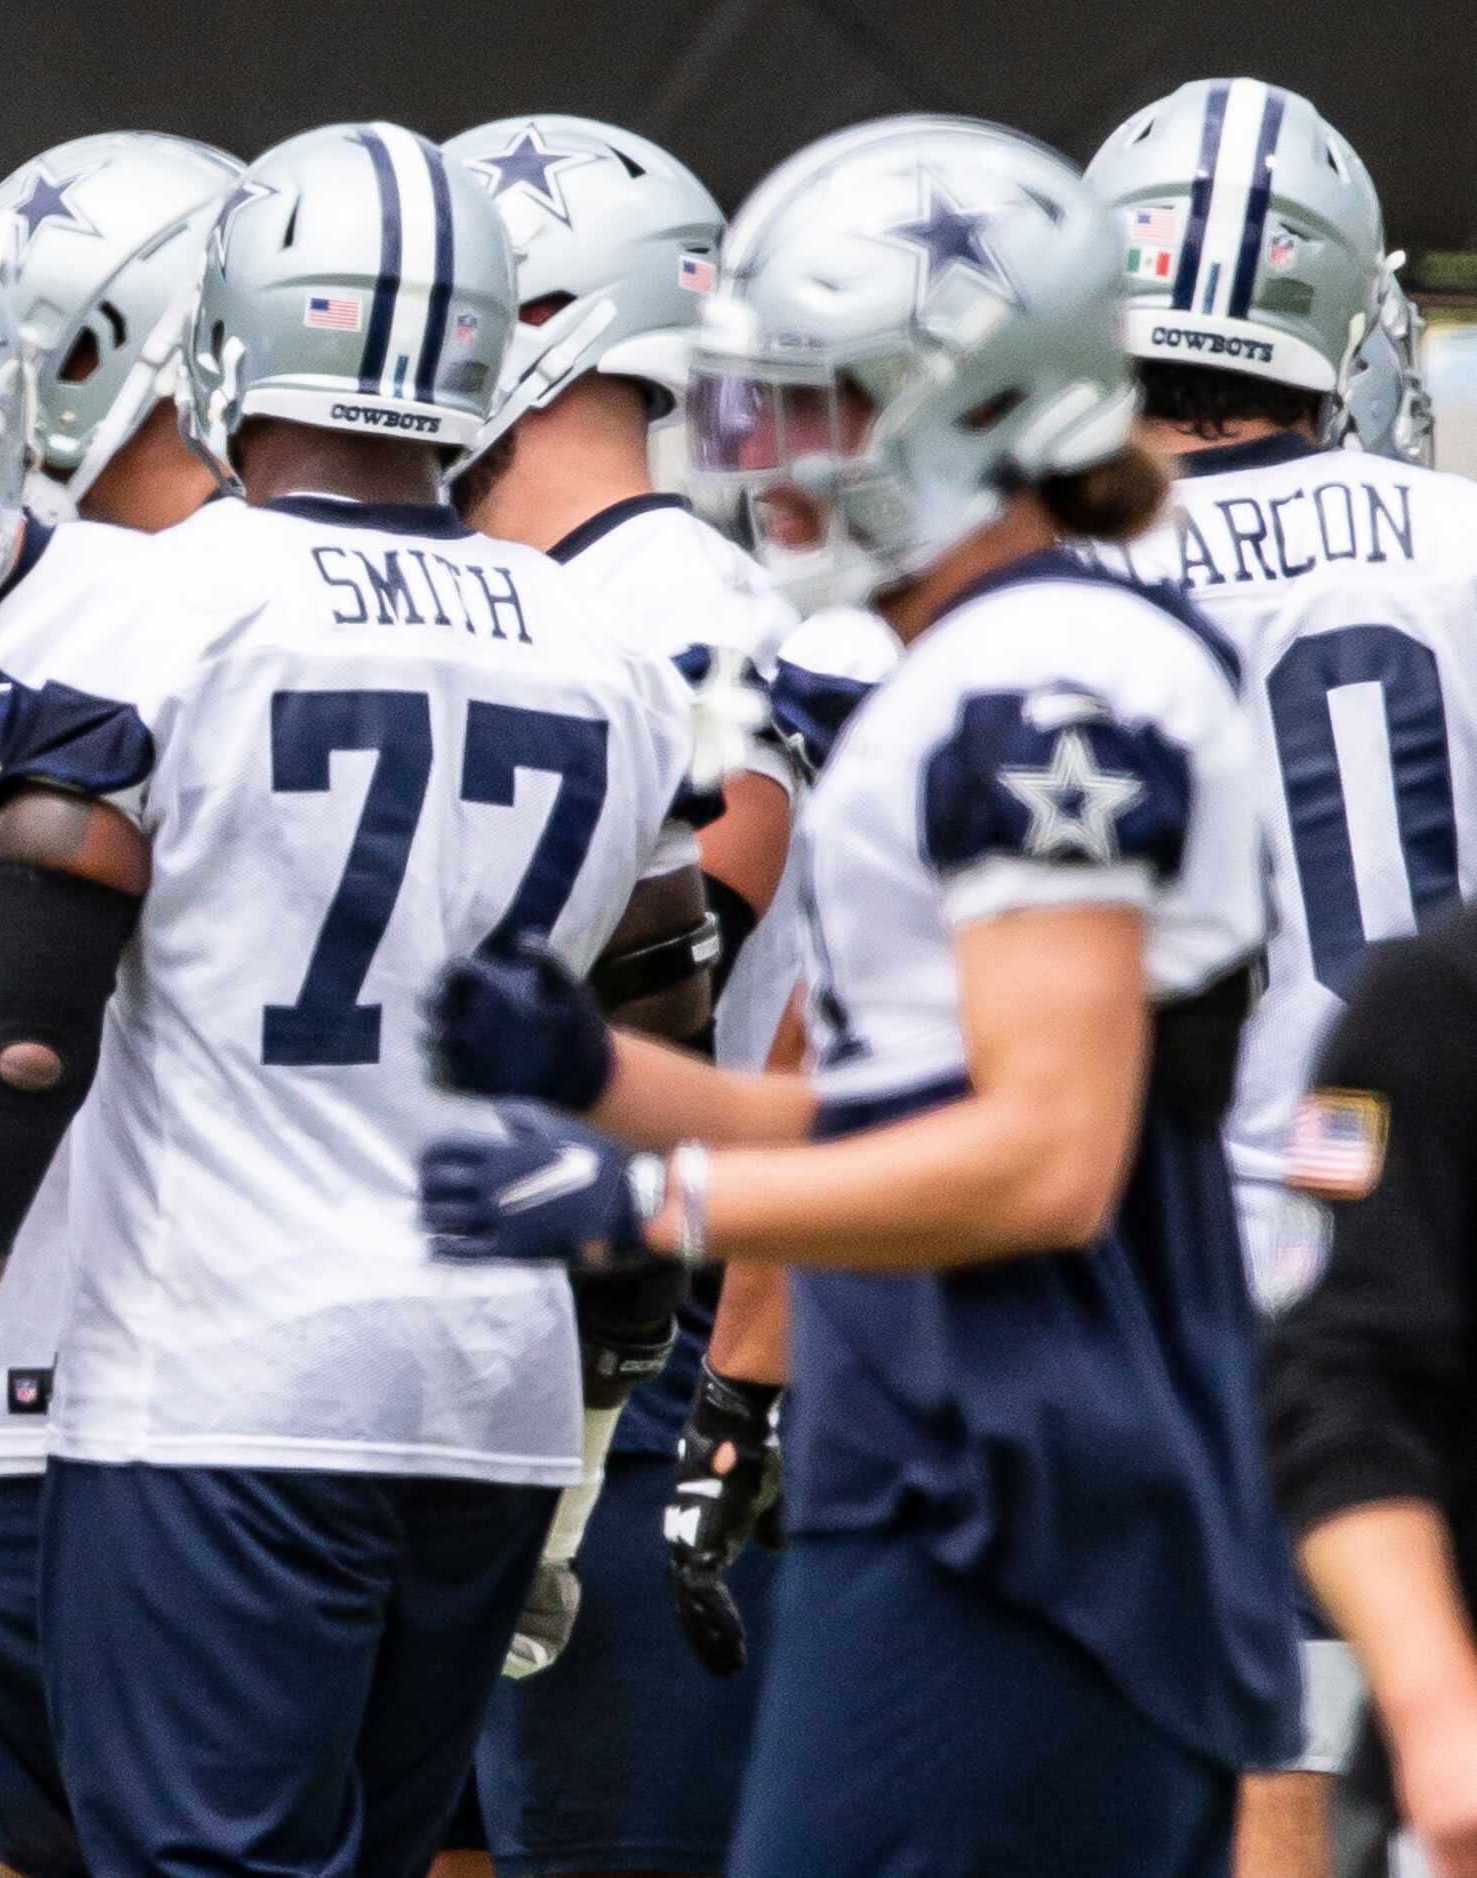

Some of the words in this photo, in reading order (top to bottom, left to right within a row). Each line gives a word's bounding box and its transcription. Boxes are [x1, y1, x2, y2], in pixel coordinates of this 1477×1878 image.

[1151, 326, 1274, 363] COWBOYS
[330, 403, 442, 433] COWBOYS
[311, 546, 533, 644] SMITH
[261, 689, 609, 1066] 77
